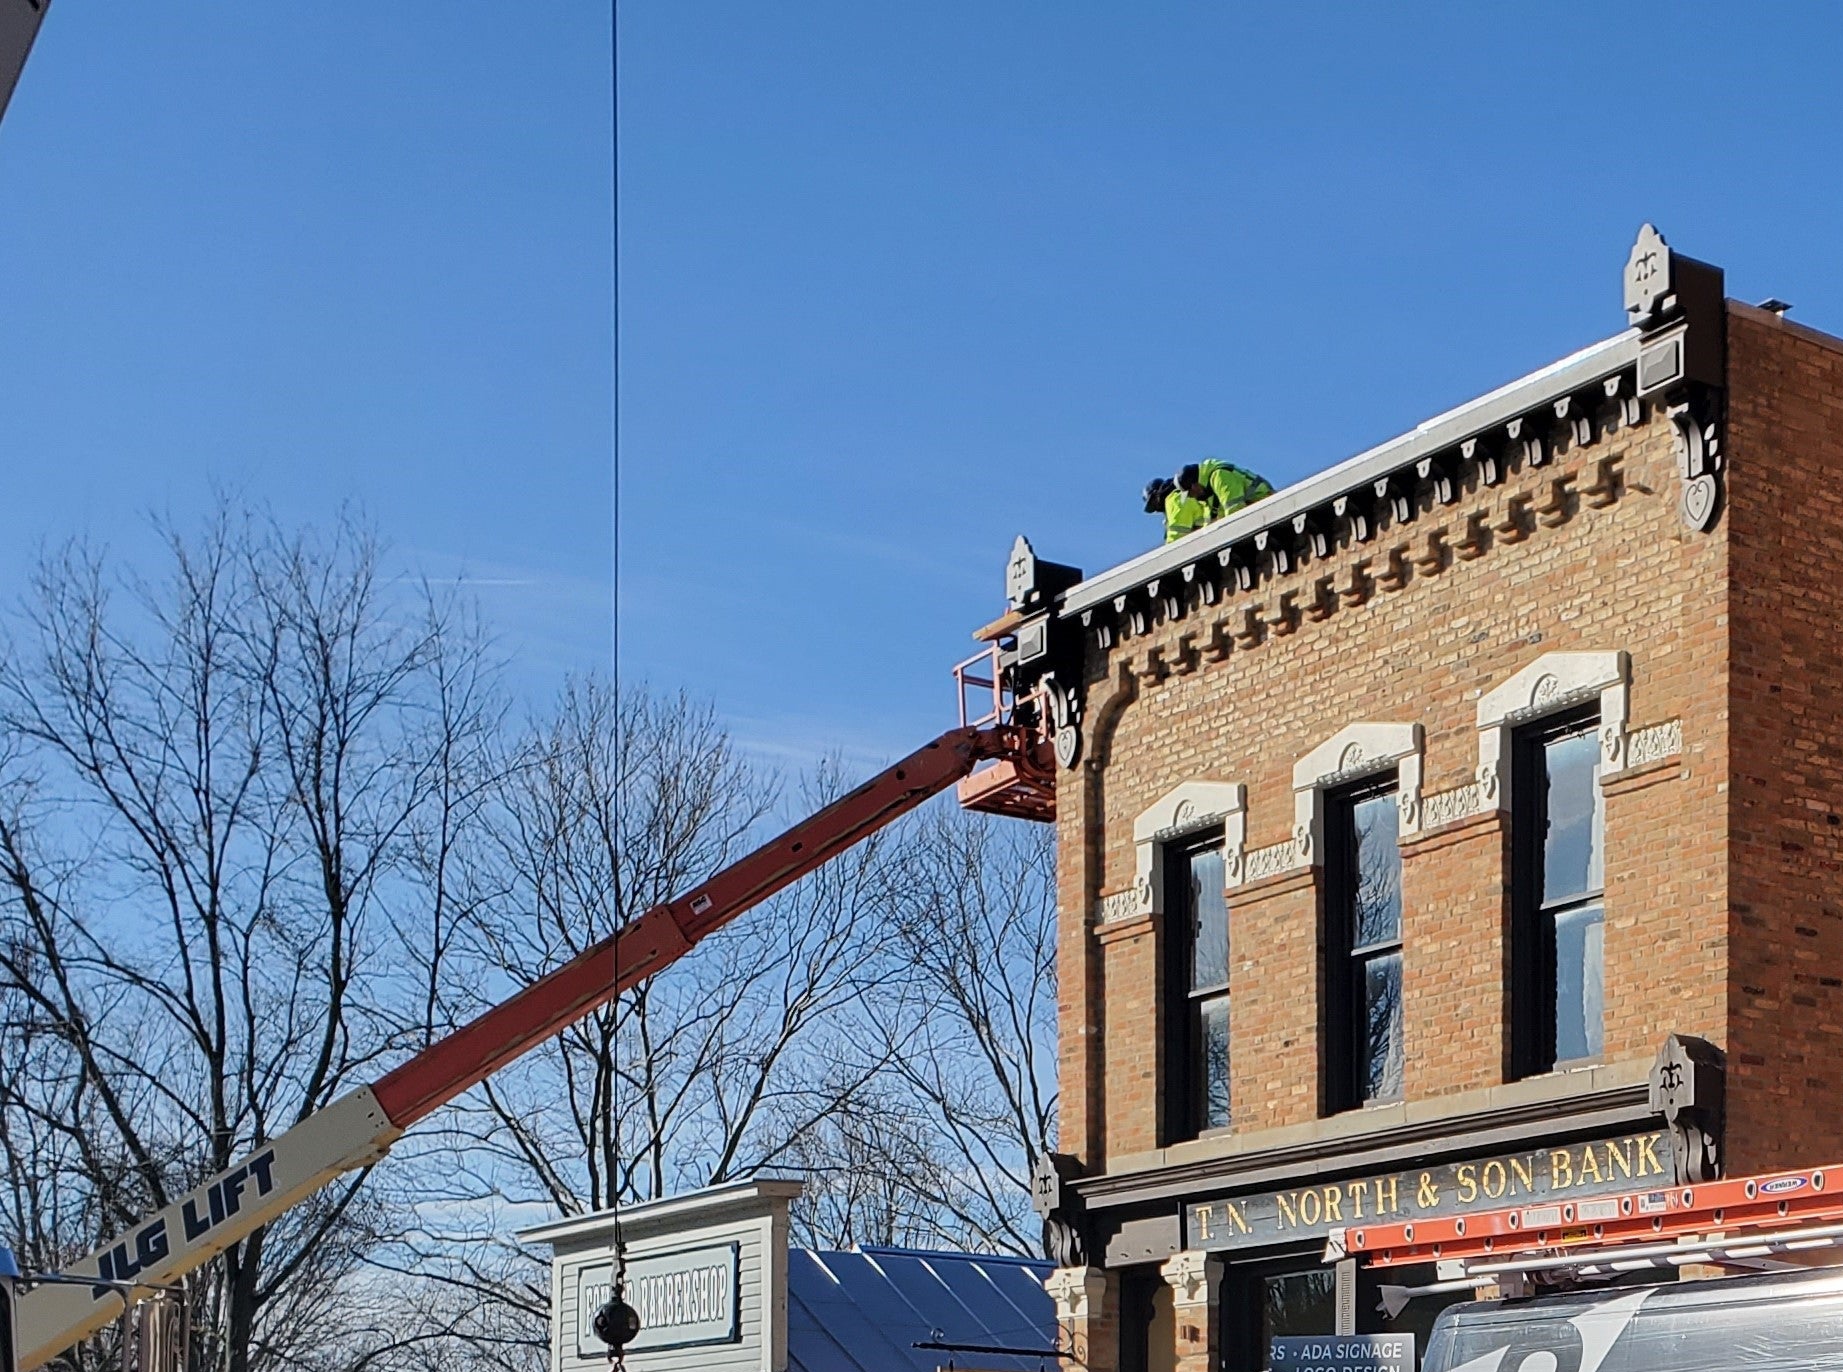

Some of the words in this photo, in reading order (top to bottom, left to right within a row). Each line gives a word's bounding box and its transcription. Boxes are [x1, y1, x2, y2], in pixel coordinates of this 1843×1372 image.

[181, 1149, 275, 1243] LIFT
[1227, 1200, 1252, 1237] N.
[1276, 1177, 1398, 1230] NORTH
[1417, 1172, 1440, 1209] &
[1456, 1154, 1534, 1204] SON
[1550, 1132, 1666, 1190] BANK
[640, 1264, 728, 1330] BARBERSHOP
[1300, 1345, 1332, 1360] ADA
[1335, 1342, 1403, 1359] SIGNAGE
